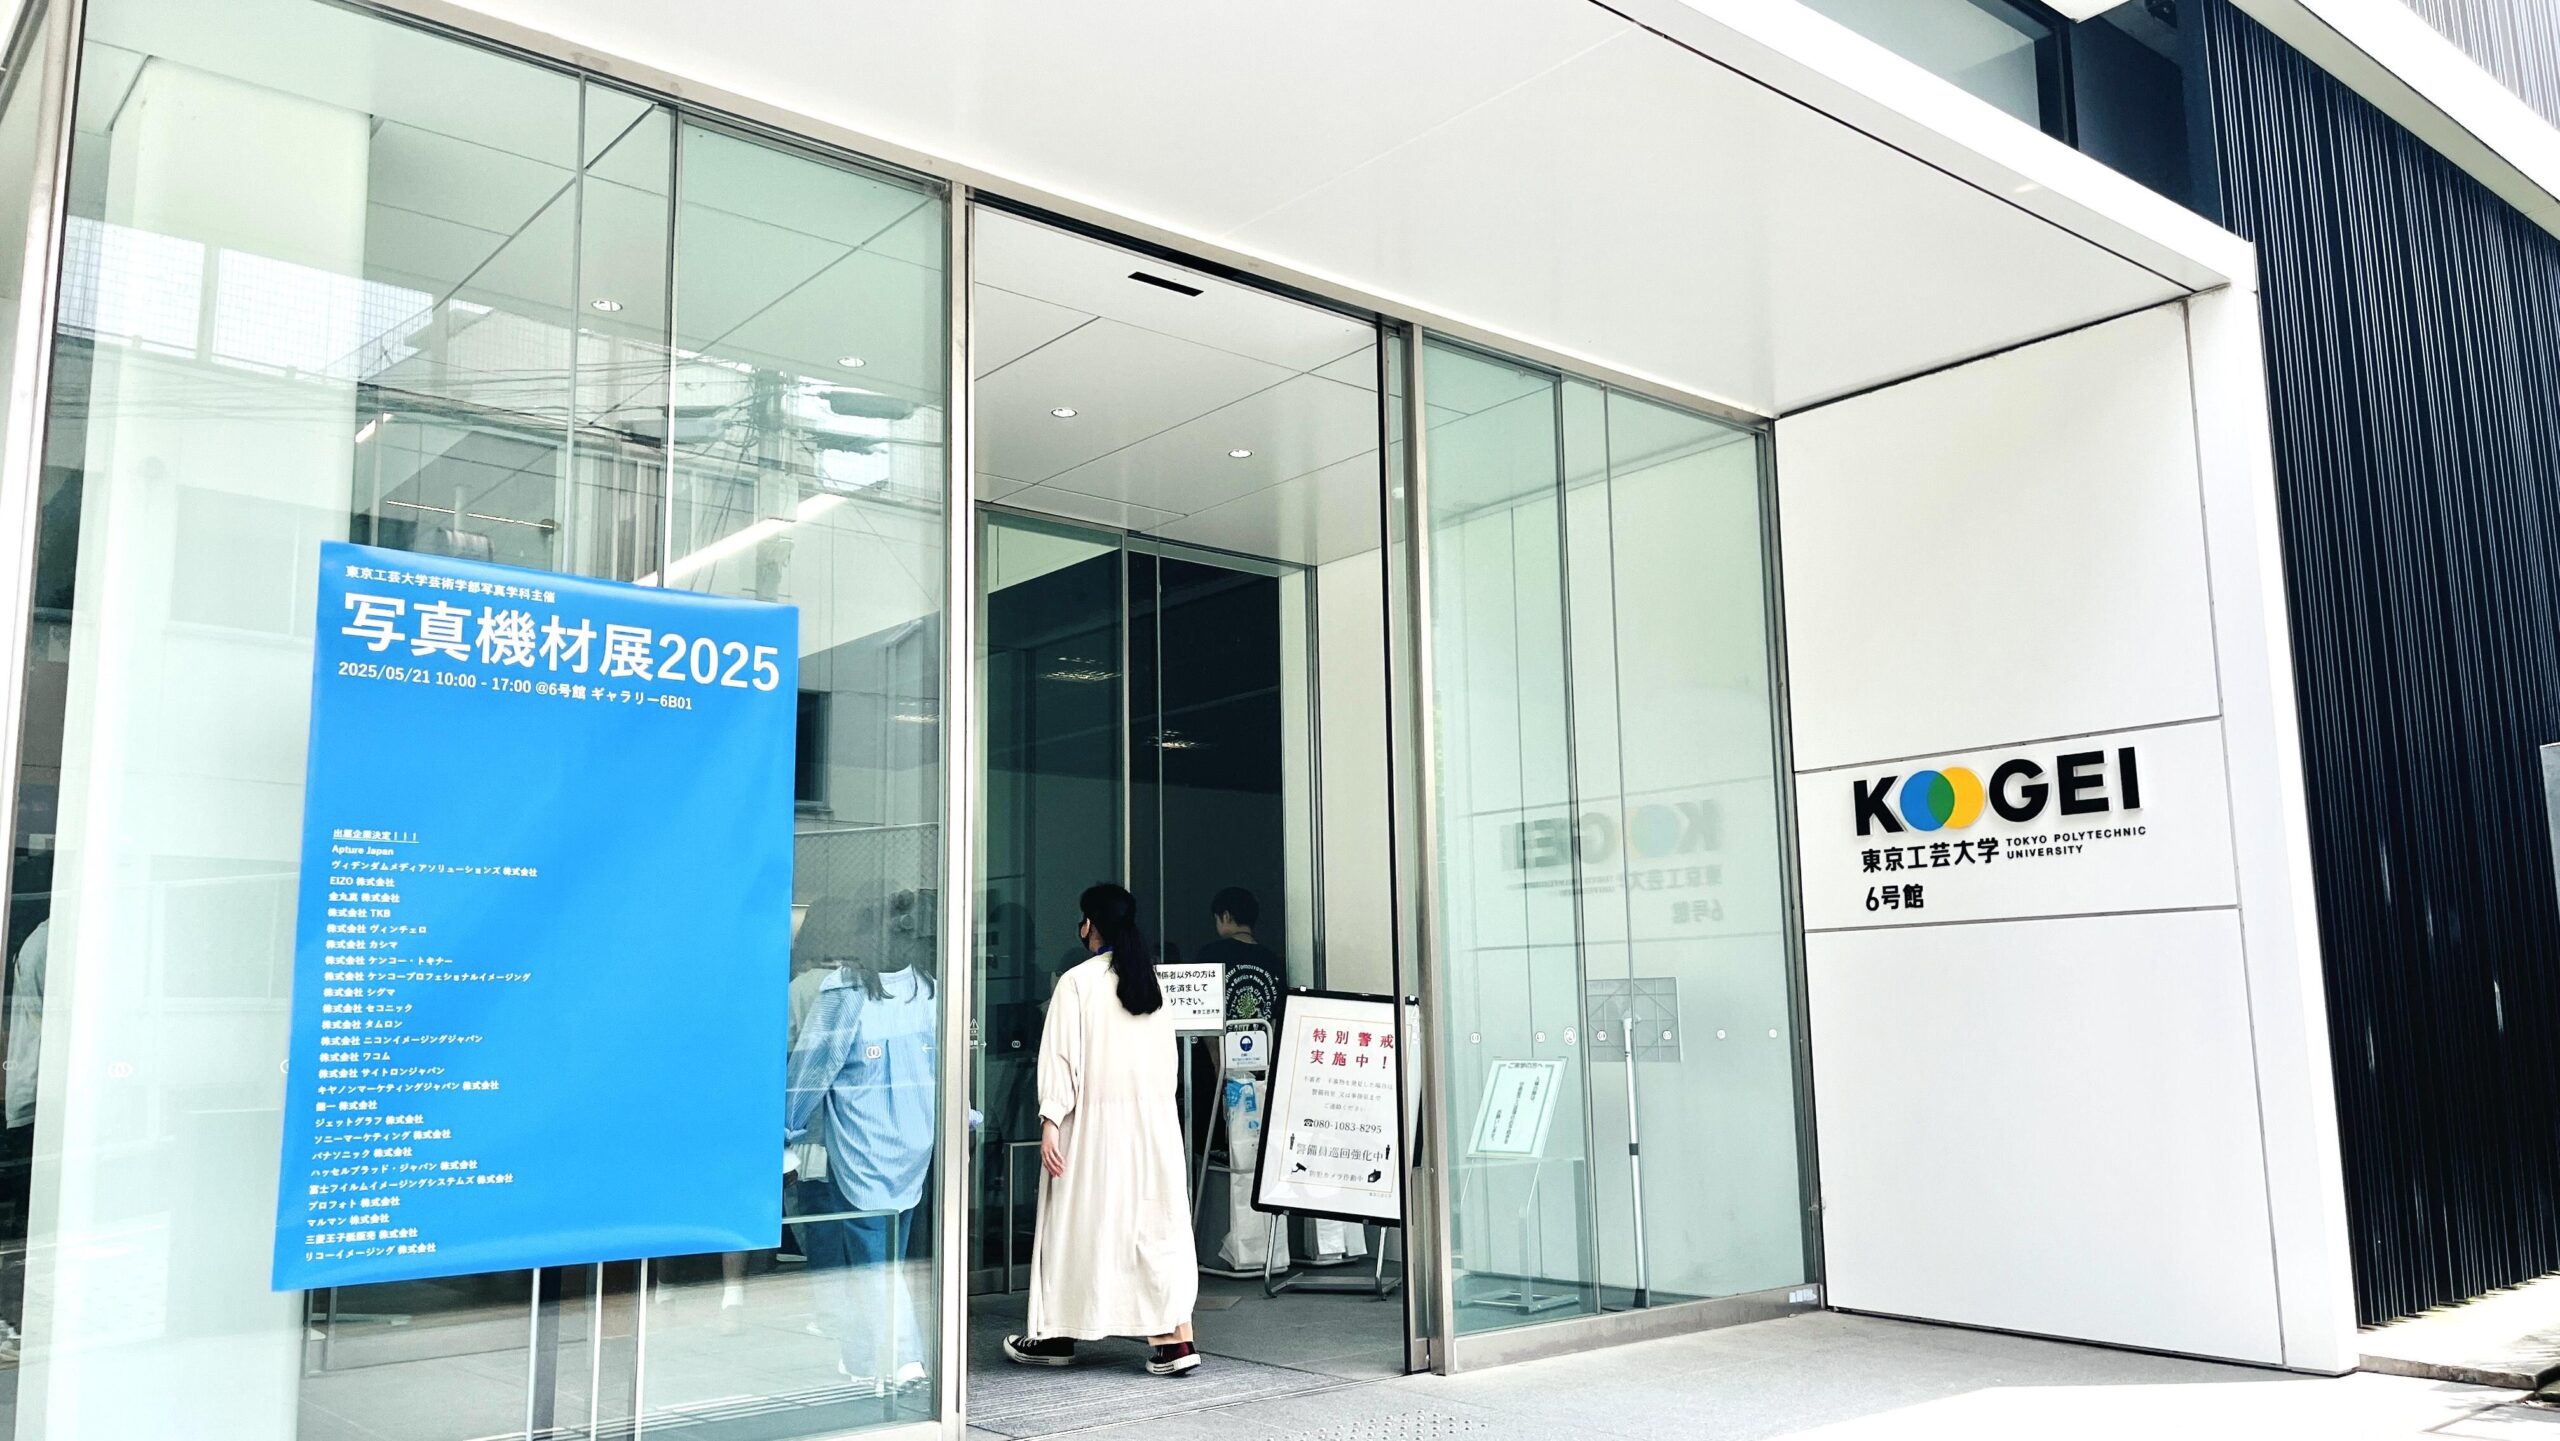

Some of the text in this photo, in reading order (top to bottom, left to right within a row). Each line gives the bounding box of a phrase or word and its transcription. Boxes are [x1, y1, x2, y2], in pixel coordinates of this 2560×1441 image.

[345, 565, 558, 603] 東京工芸大学芸術学部写真学科主催
[342, 592, 779, 691] 写真機材展2025
[591, 688, 692, 710] ギャラリー6B01
[2006, 826, 2147, 846] TOKYO POLYTECHNIC
[332, 845, 364, 855] Apture
[1861, 838, 2000, 874] 東京工芸大学
[2007, 845, 2083, 859] UNIVERSITY
[1865, 884, 1924, 911] 6号館
[1312, 1028, 1394, 1049] 特別警戒
[1310, 1050, 1388, 1069] 実施中！
[1296, 1143, 1383, 1162] 警備員巡回強化中
